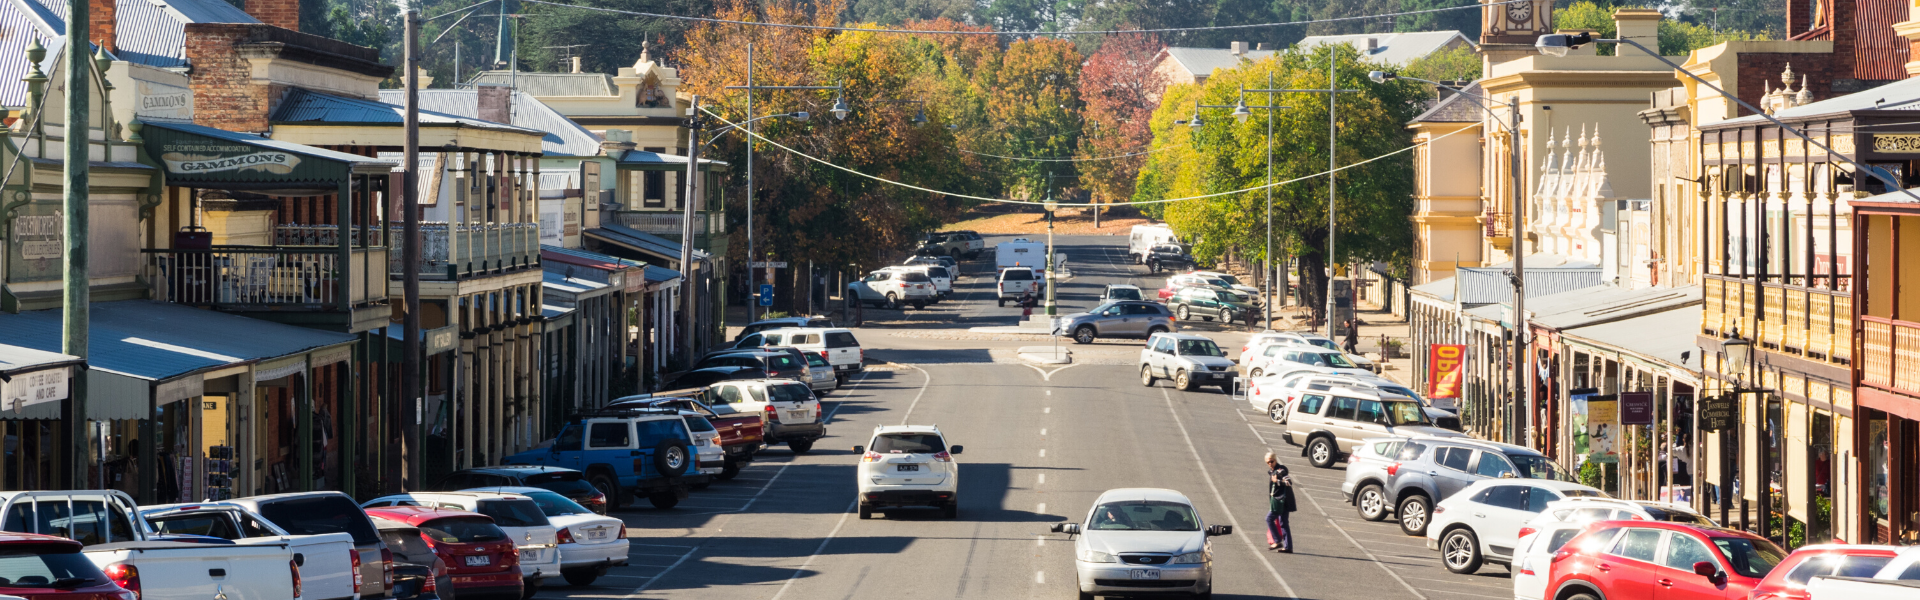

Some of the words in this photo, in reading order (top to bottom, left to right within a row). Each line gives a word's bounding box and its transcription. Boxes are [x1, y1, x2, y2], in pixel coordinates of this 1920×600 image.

[143, 93, 186, 109] GAMMONS
[181, 154, 286, 171] GAMMONS
[763, 287, 769, 295] P
[29, 374, 44, 388] COFFEE
[45, 372, 62, 385] ROASTER
[36, 388, 45, 400] AND
[46, 386, 56, 398] CAFE
[1705, 400, 1730, 411] TANSWELLS
[1701, 409, 1730, 420] COMMERCIAL
[1711, 418, 1726, 428] HOTEL
